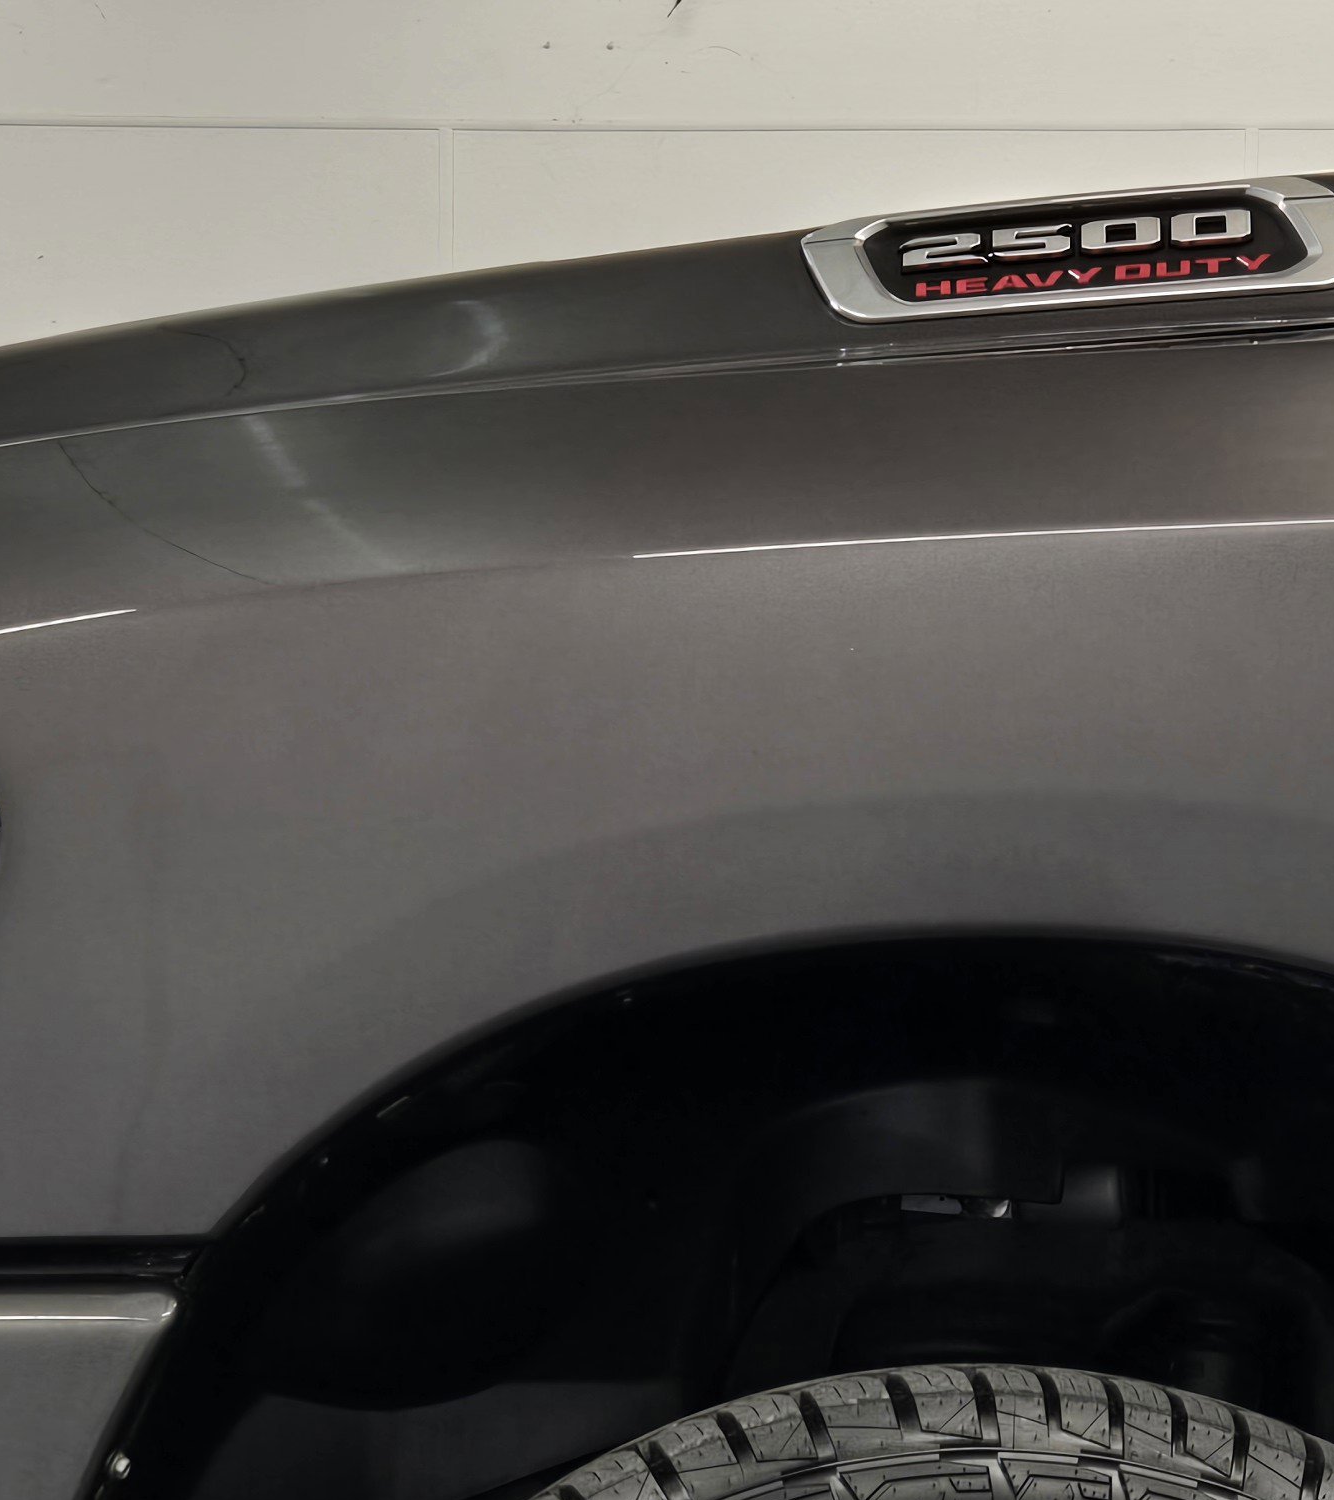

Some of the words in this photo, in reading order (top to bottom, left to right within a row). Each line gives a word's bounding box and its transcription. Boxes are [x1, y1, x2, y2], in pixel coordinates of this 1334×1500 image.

[900, 208, 1253, 269] 2500
[914, 266, 1103, 298] HEAVY
[1114, 253, 1272, 281] DUTY
